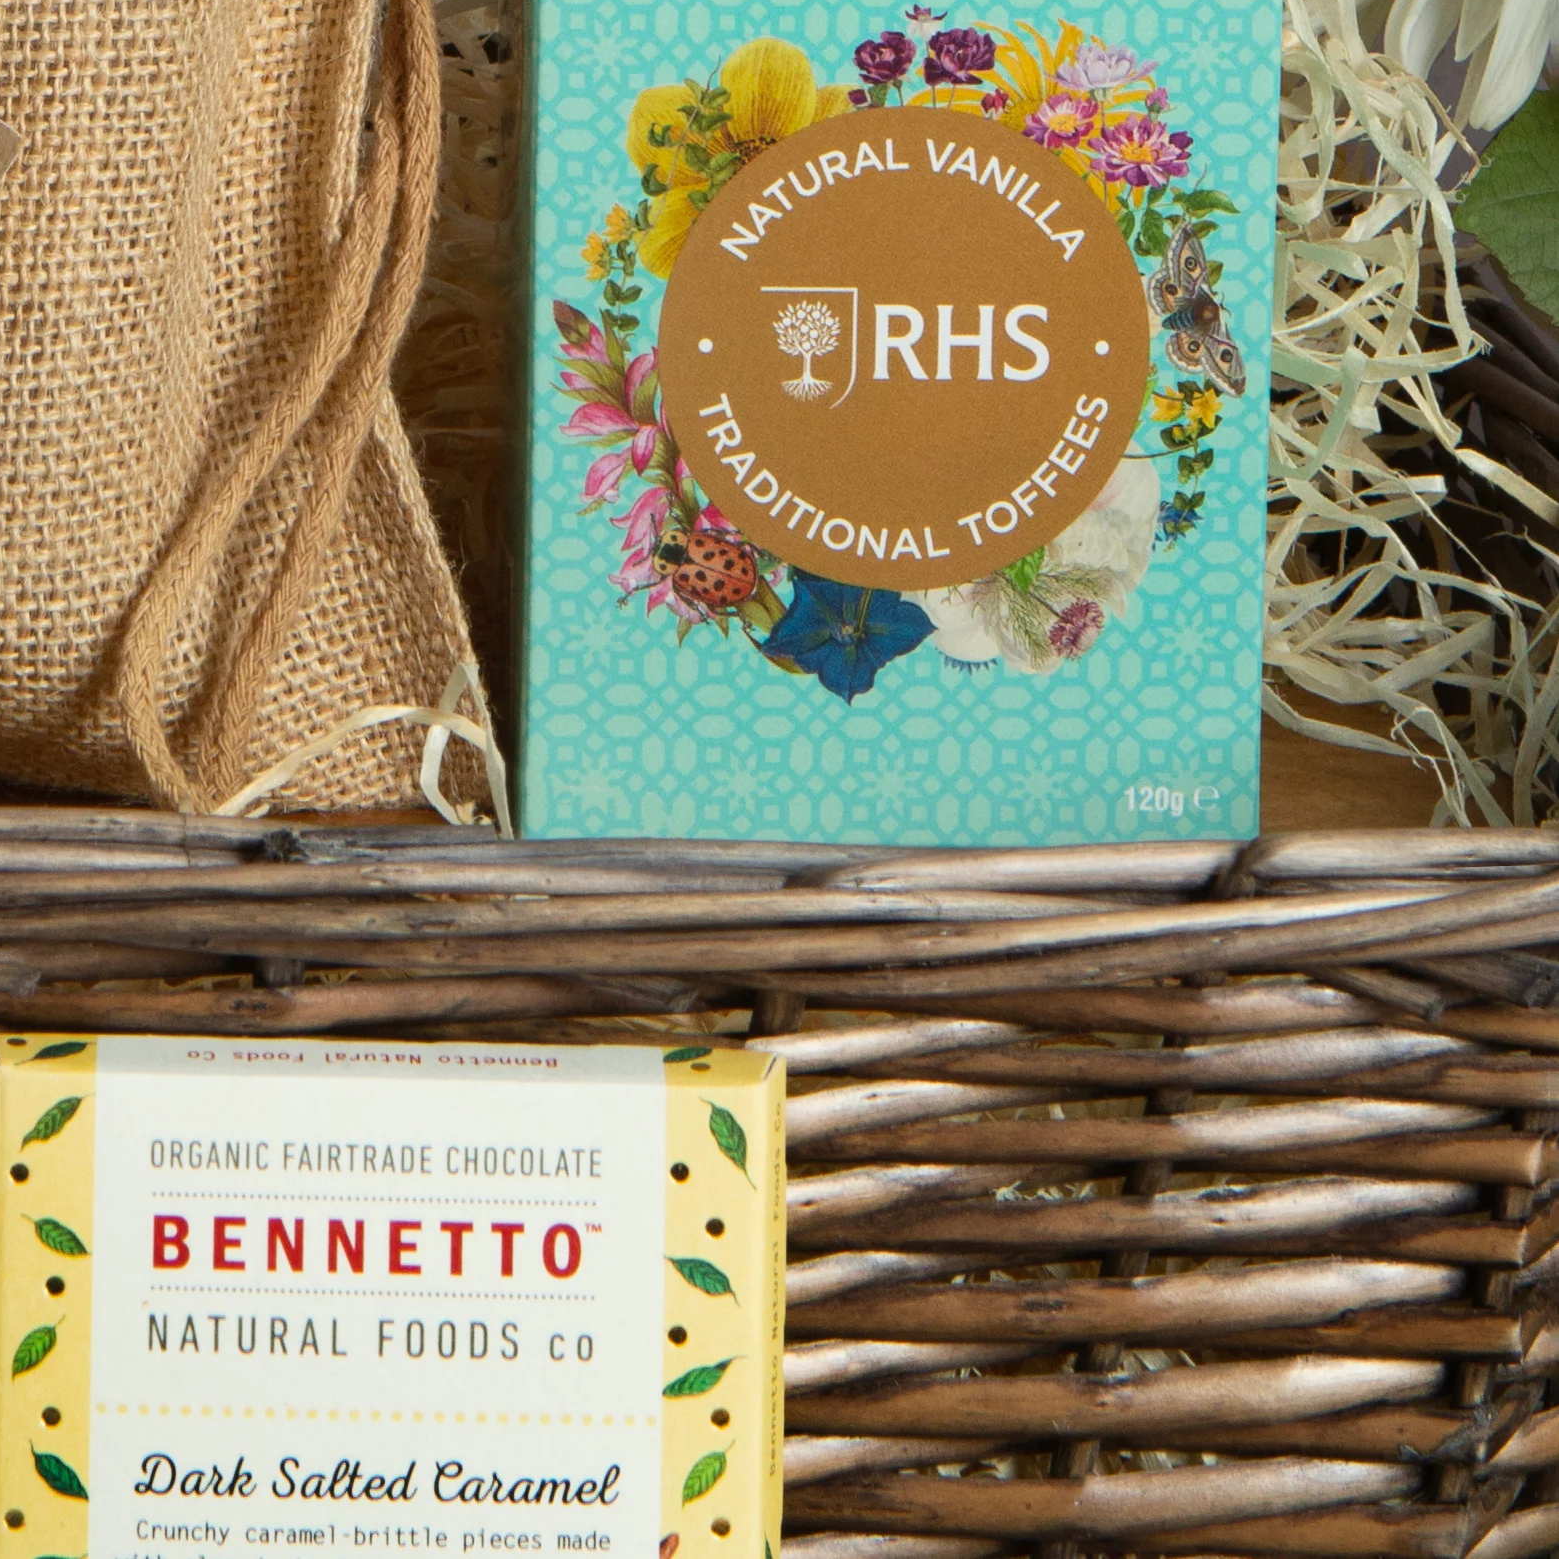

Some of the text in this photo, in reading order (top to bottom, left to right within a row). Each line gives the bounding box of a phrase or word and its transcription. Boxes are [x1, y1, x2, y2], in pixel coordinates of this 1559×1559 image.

[720, 138, 1086, 261] NATURAL VANILLA
[872, 303, 1051, 382] RHS
[698, 393, 1109, 560] TRADITIONAL TOFFEES
[1124, 786, 1185, 817] 120g
[187, 1050, 558, 1069] Bennetto Natural Foods Co
[150, 1139, 603, 1178] ORGANIC FAIRTRADE CHOCOLATE
[771, 1241, 780, 1340] Natural
[147, 1314, 348, 1357] NATURAL
[378, 1319, 520, 1361] FOODS
[769, 1354, 778, 1478] Bennetto
[134, 1453, 622, 1506] Dark Salted Caramel
[136, 1519, 611, 1552] Crunchy caramel-brittle pieces made
